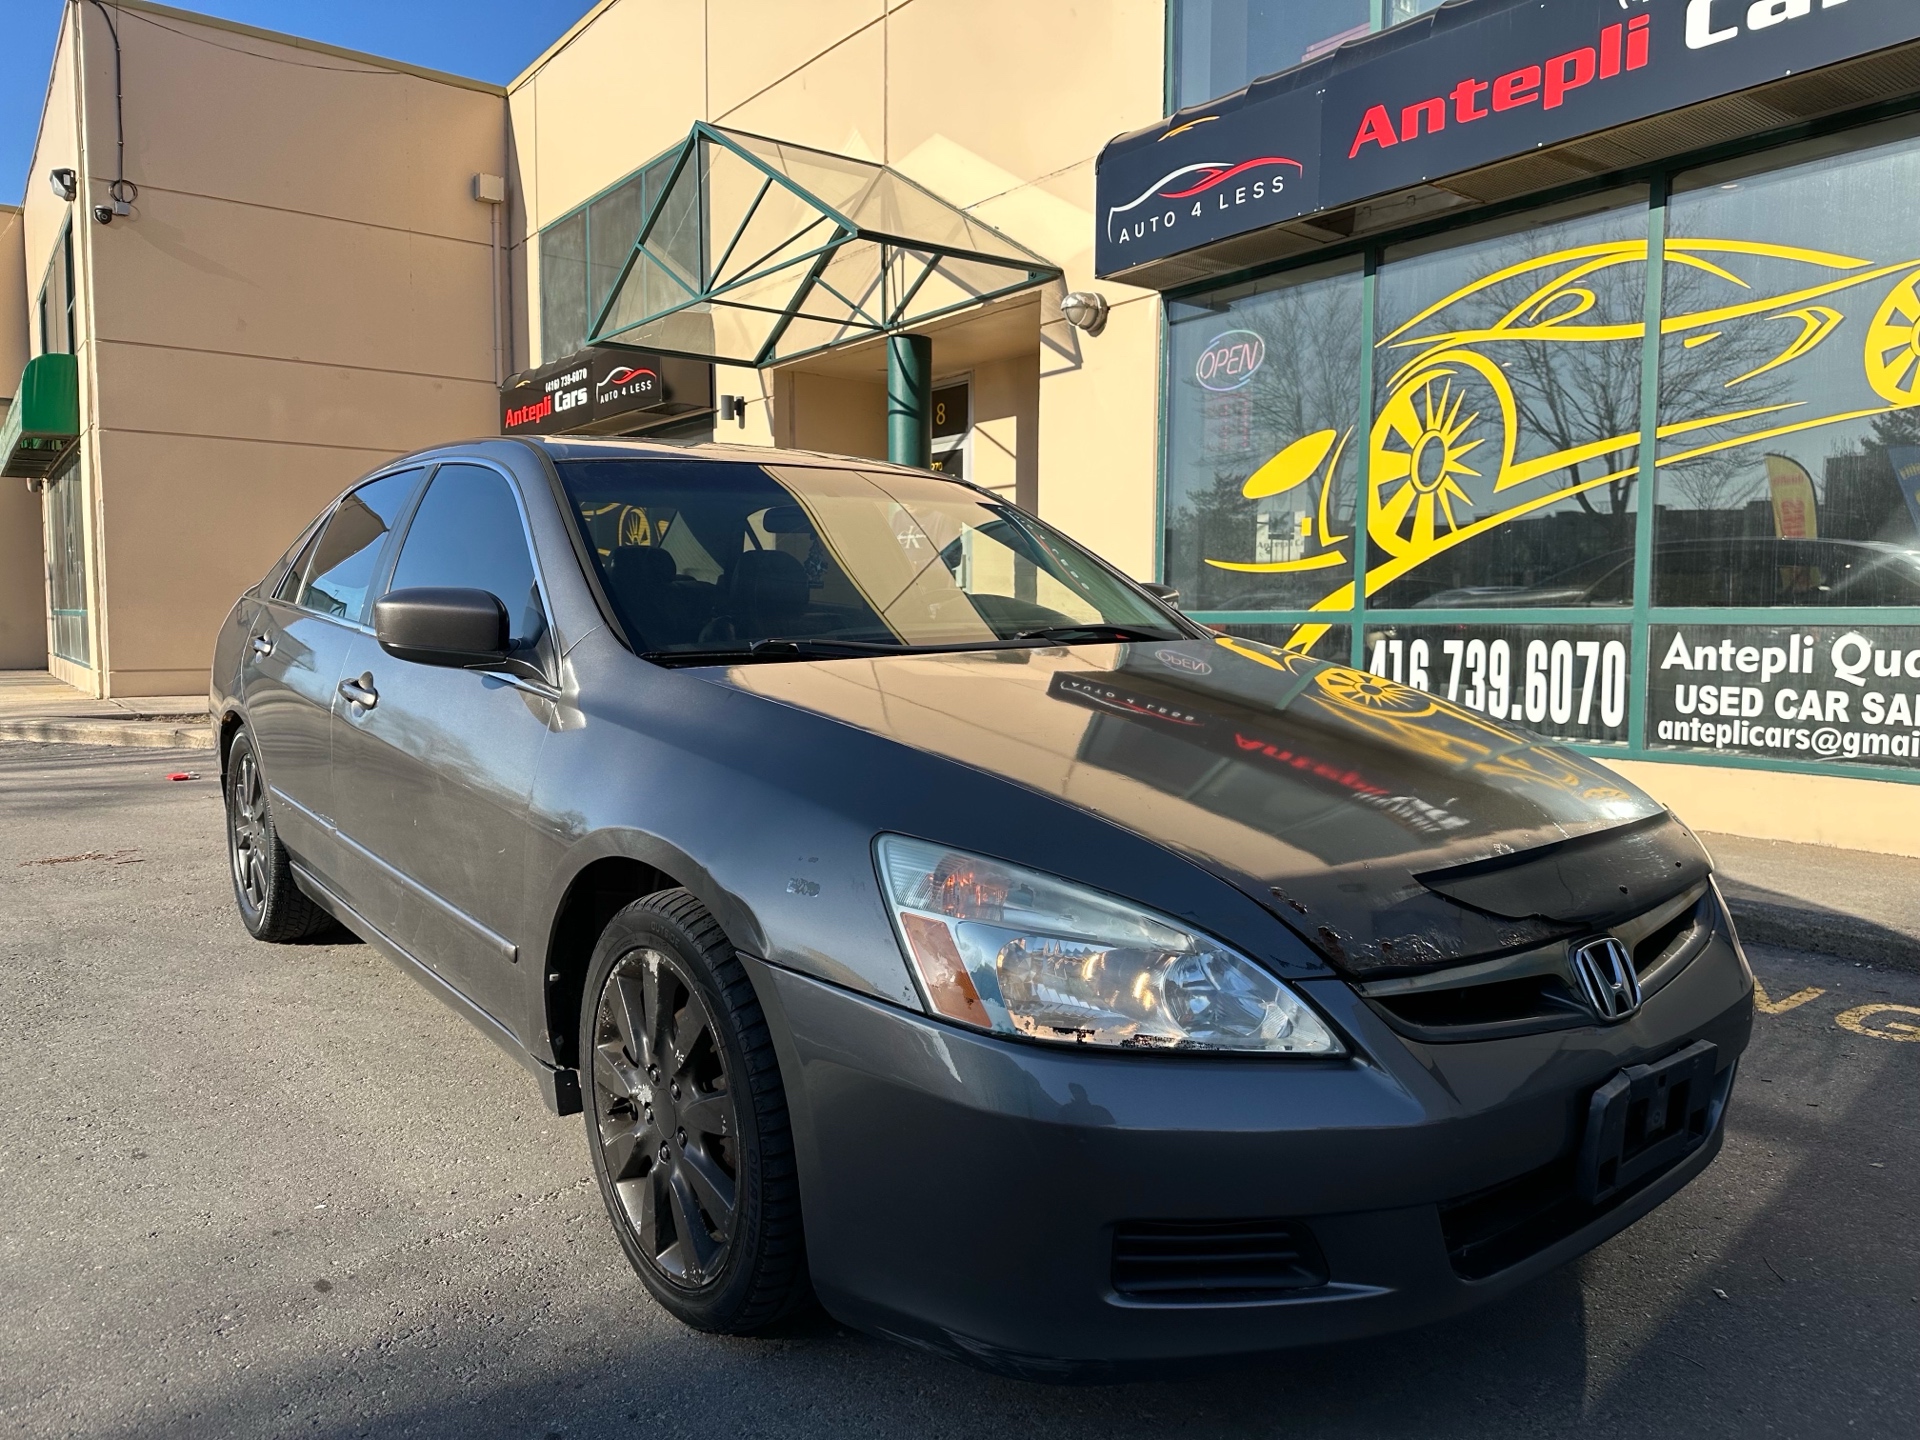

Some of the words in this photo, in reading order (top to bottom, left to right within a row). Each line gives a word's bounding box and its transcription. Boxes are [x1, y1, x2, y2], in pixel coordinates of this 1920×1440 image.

[1348, 13, 1650, 159] Antepli
[1118, 210, 1177, 244] AUTO
[1190, 201, 1202, 218] 4
[1219, 175, 1285, 210] LESS
[1199, 341, 1259, 380] OPEN
[505, 394, 552, 429] Antepli
[554, 387, 588, 412] Cars
[599, 389, 619, 404] AUTO
[621, 387, 627, 396] 4
[630, 379, 652, 394] LESS
[935, 402, 946, 425] 8
[1660, 631, 1815, 683] Antepli
[1674, 684, 1764, 718] USED
[1774, 688, 1850, 723] CAR
